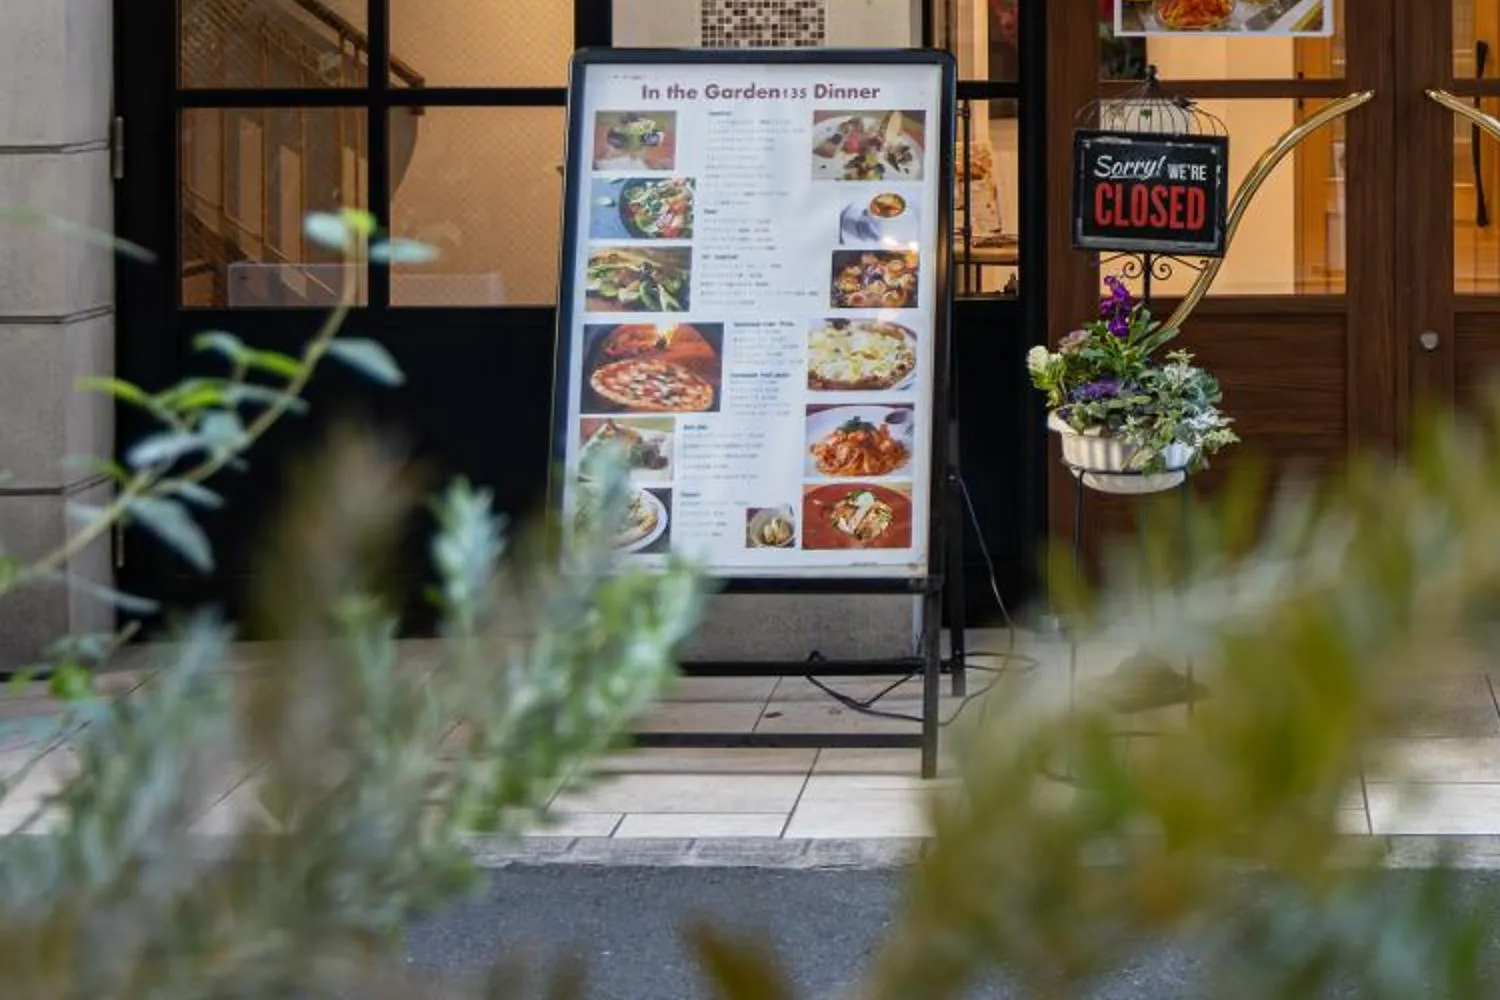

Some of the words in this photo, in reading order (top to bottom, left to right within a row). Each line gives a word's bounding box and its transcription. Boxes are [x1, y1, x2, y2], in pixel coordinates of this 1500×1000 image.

[641, 83, 660, 100] In
[666, 82, 698, 100] the
[813, 82, 881, 100] Dinner
[1093, 154, 1168, 181] Sorry!
[1167, 163, 1208, 182] WE'RE
[1093, 181, 1207, 231] CLOSED
